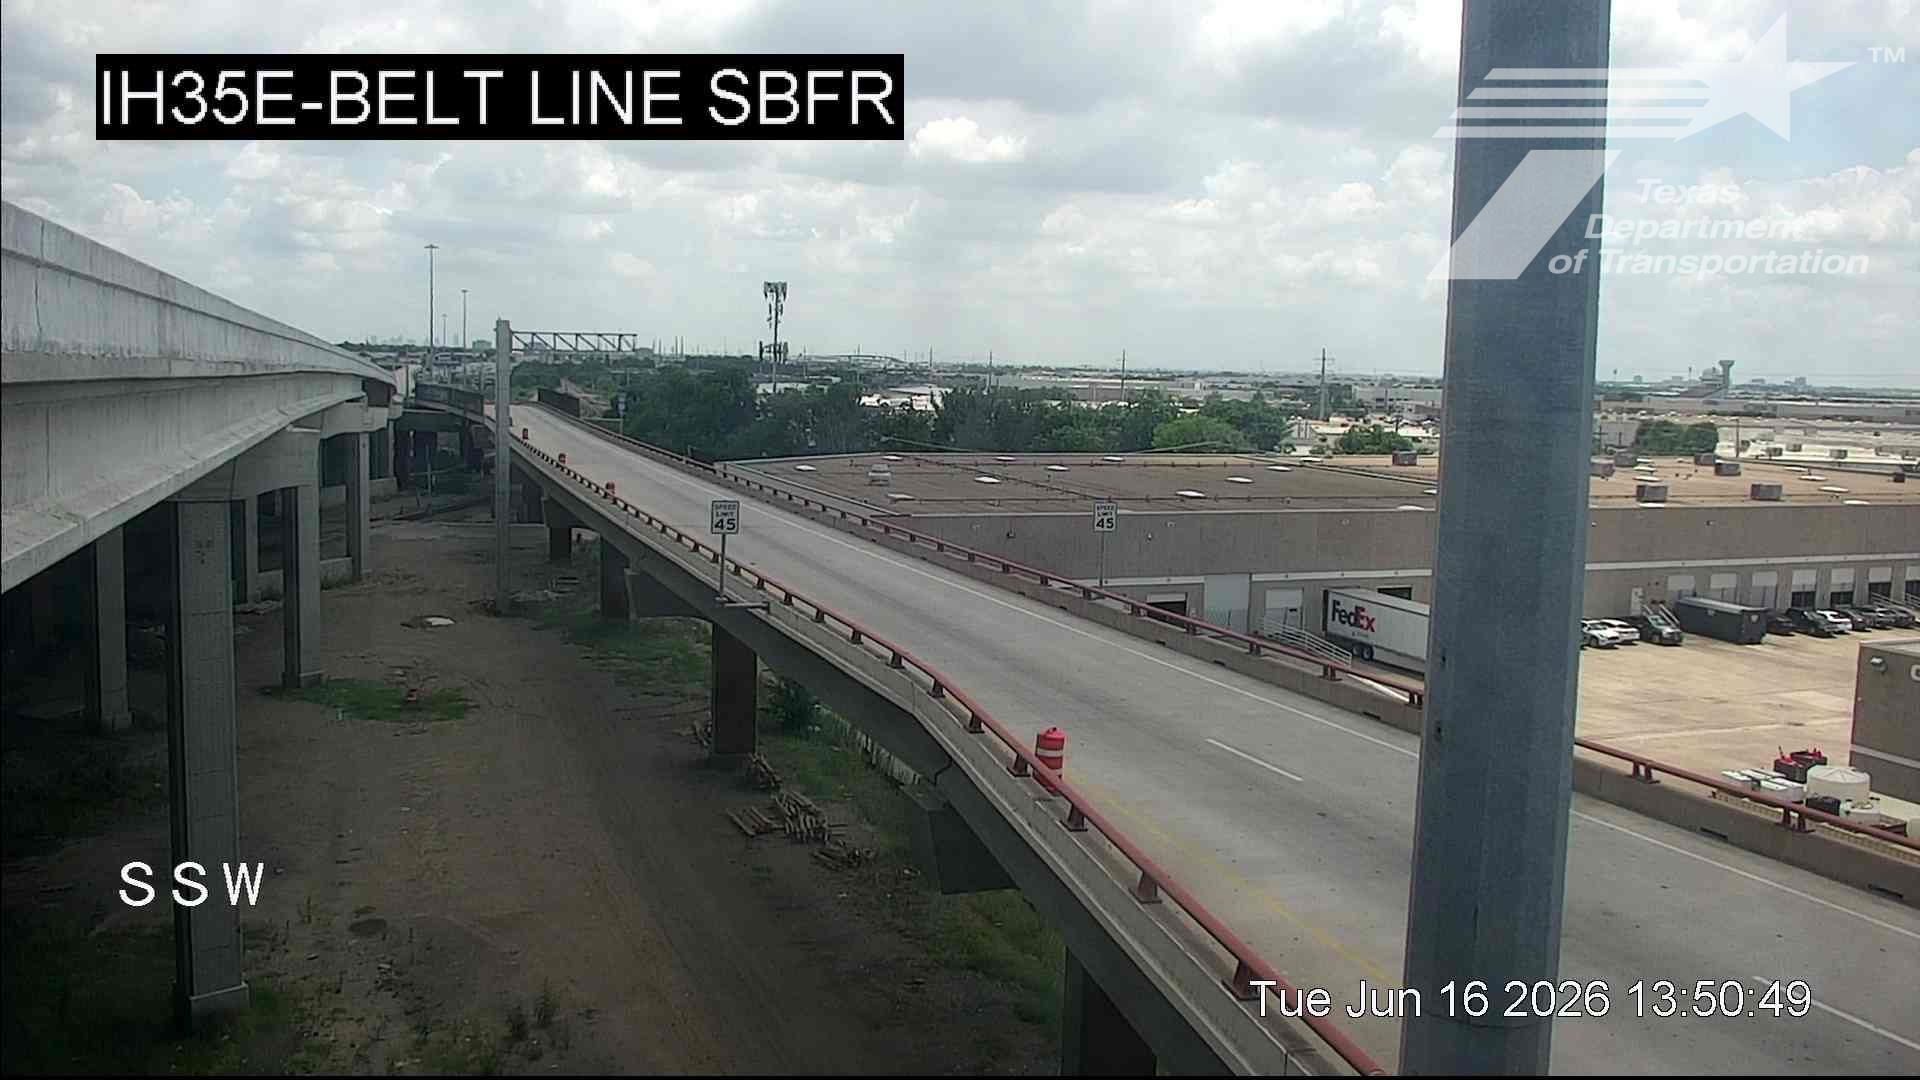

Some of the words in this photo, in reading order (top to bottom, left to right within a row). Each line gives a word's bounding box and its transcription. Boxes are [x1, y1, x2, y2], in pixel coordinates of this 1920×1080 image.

[714, 518, 736, 531] 45
[1096, 517, 1114, 529] 45
[1331, 599, 1376, 633] FedEx
